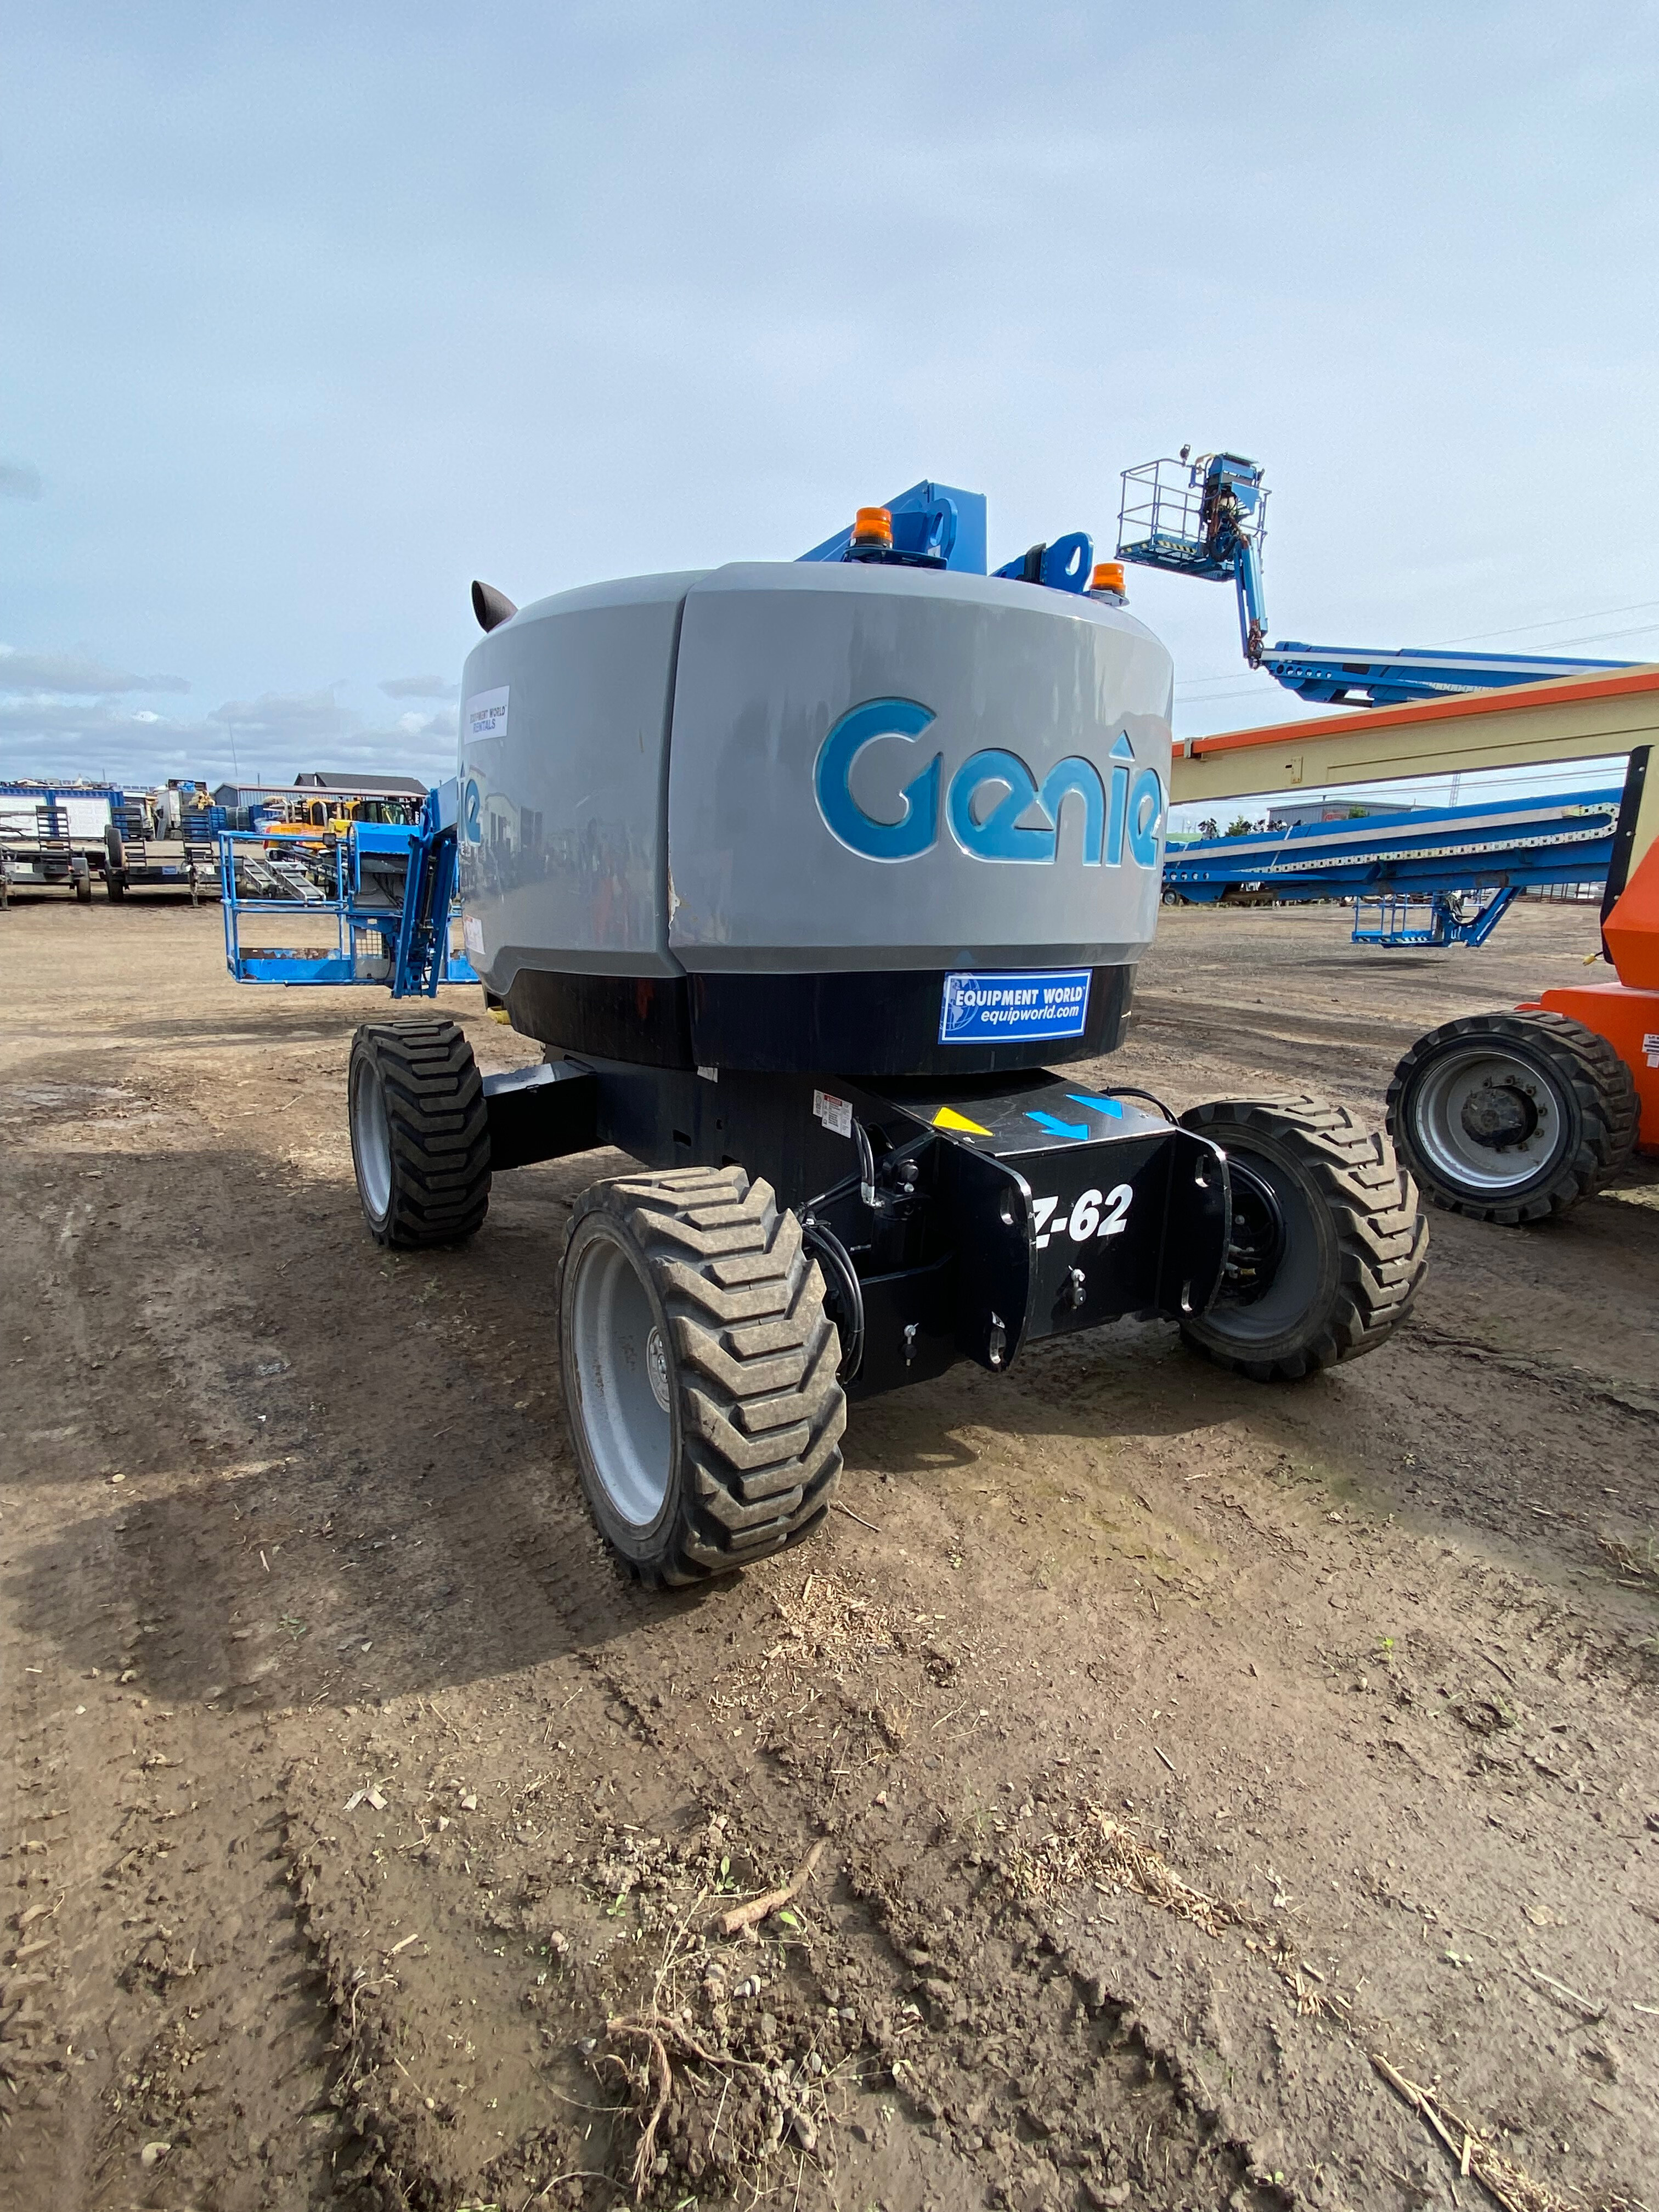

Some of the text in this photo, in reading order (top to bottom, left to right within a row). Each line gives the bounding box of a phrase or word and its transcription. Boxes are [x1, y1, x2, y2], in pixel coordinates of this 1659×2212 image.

[489, 706, 505, 718] WORLD
[473, 718, 495, 734] RENTALS
[812, 696, 1161, 870] Genie
[955, 986, 1083, 1007] EQUIPMENT WORLD
[980, 1005, 1079, 1025] equipworld.com
[1032, 1183, 1133, 1249] Z-62
